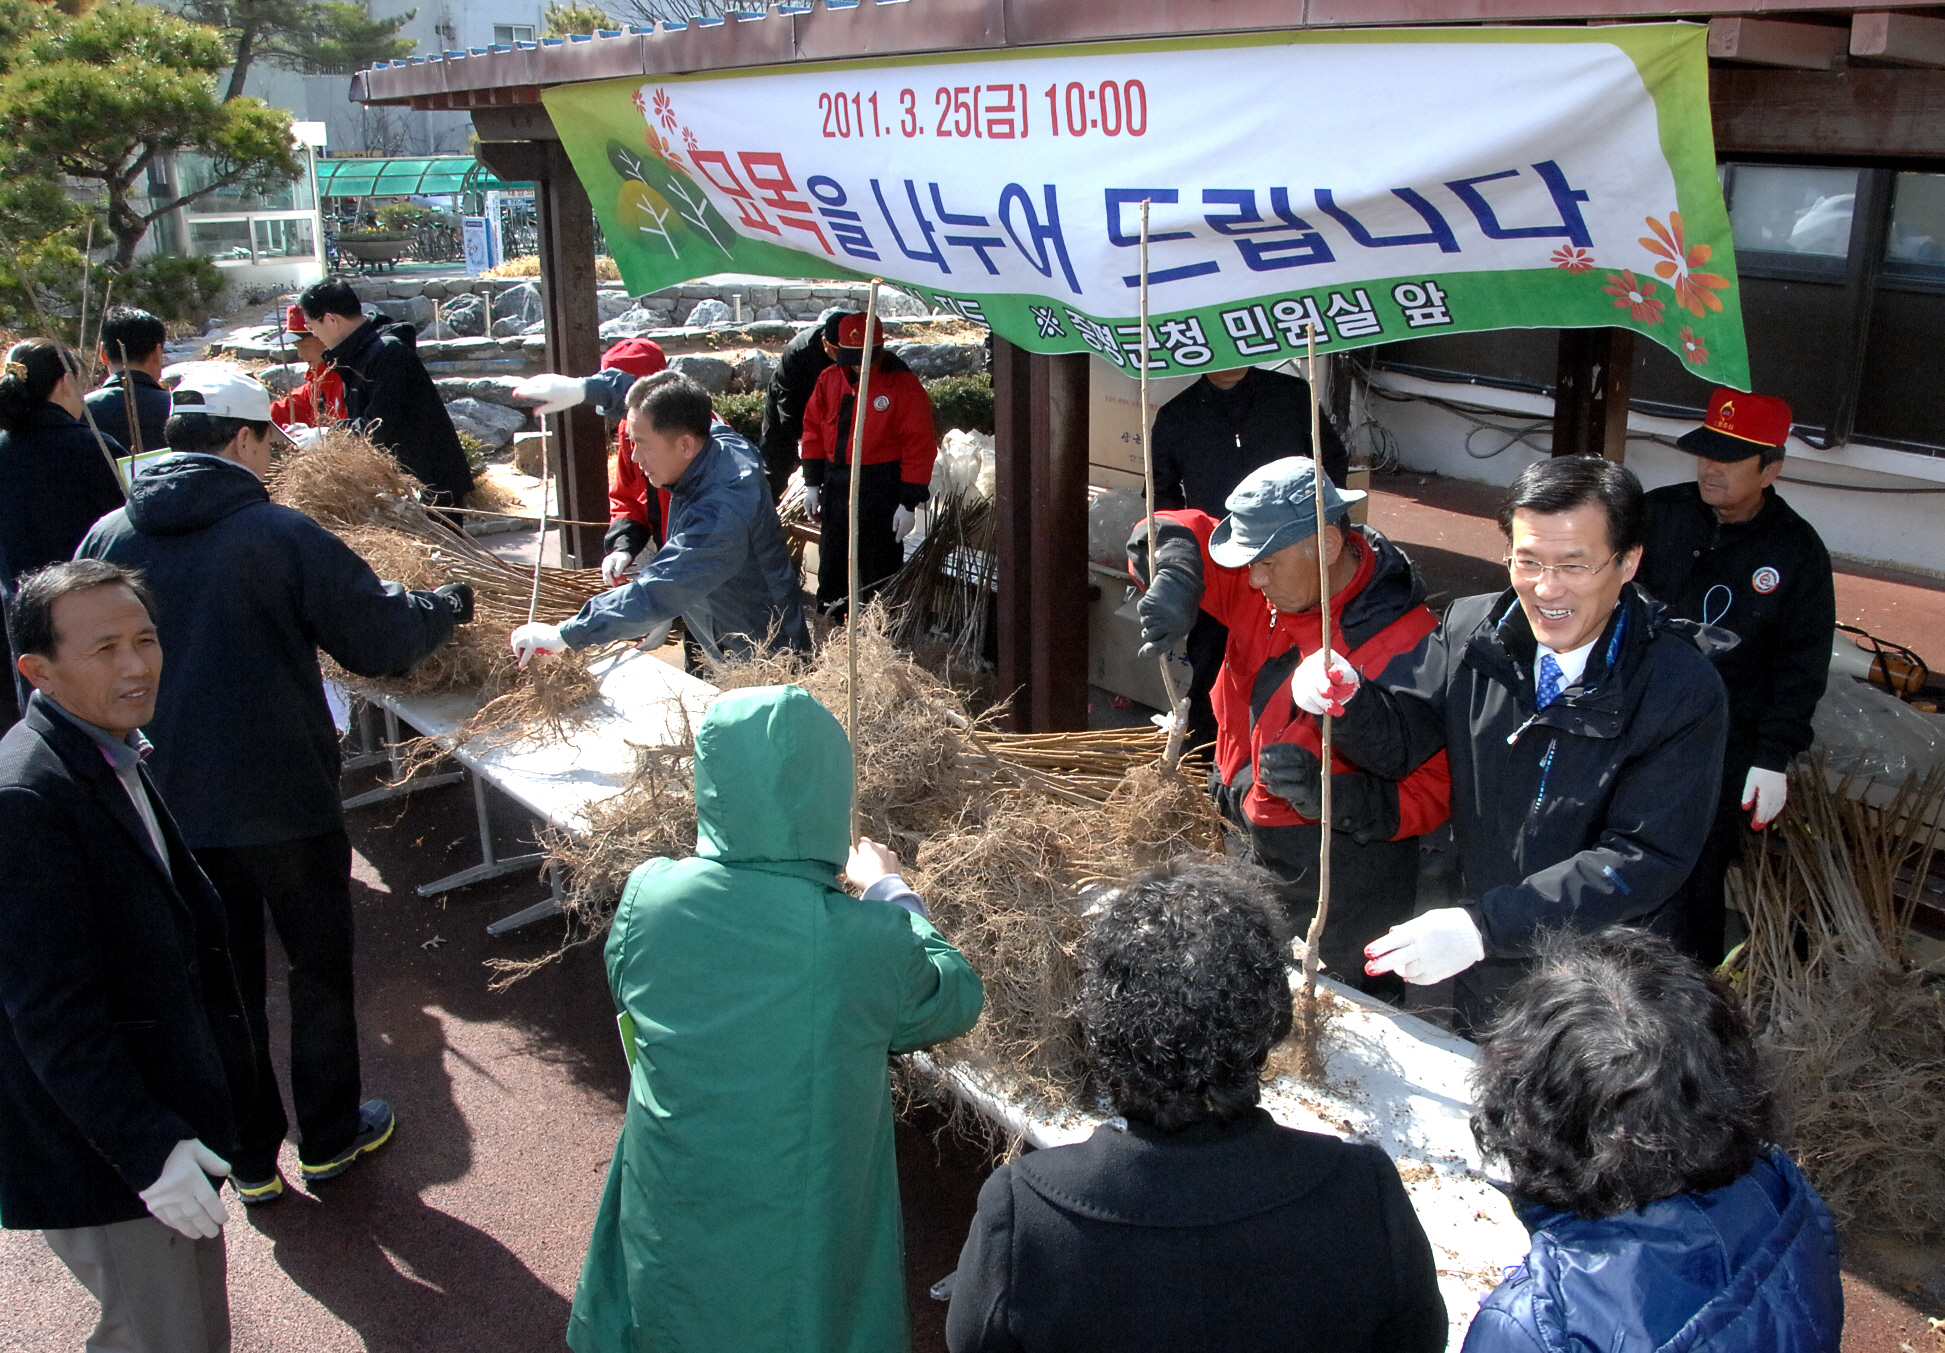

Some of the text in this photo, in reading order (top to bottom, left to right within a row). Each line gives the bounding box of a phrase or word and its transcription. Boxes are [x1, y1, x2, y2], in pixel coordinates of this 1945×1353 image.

[819, 79, 1147, 139] 2011. 3. 25(금) 10:00
[687, 150, 1594, 295] 묘목을 나누어 드립니다
[1063, 306, 1215, 369] 증평군청
[1219, 287, 1384, 358] 민원실
[1391, 280, 1454, 328] 앞
